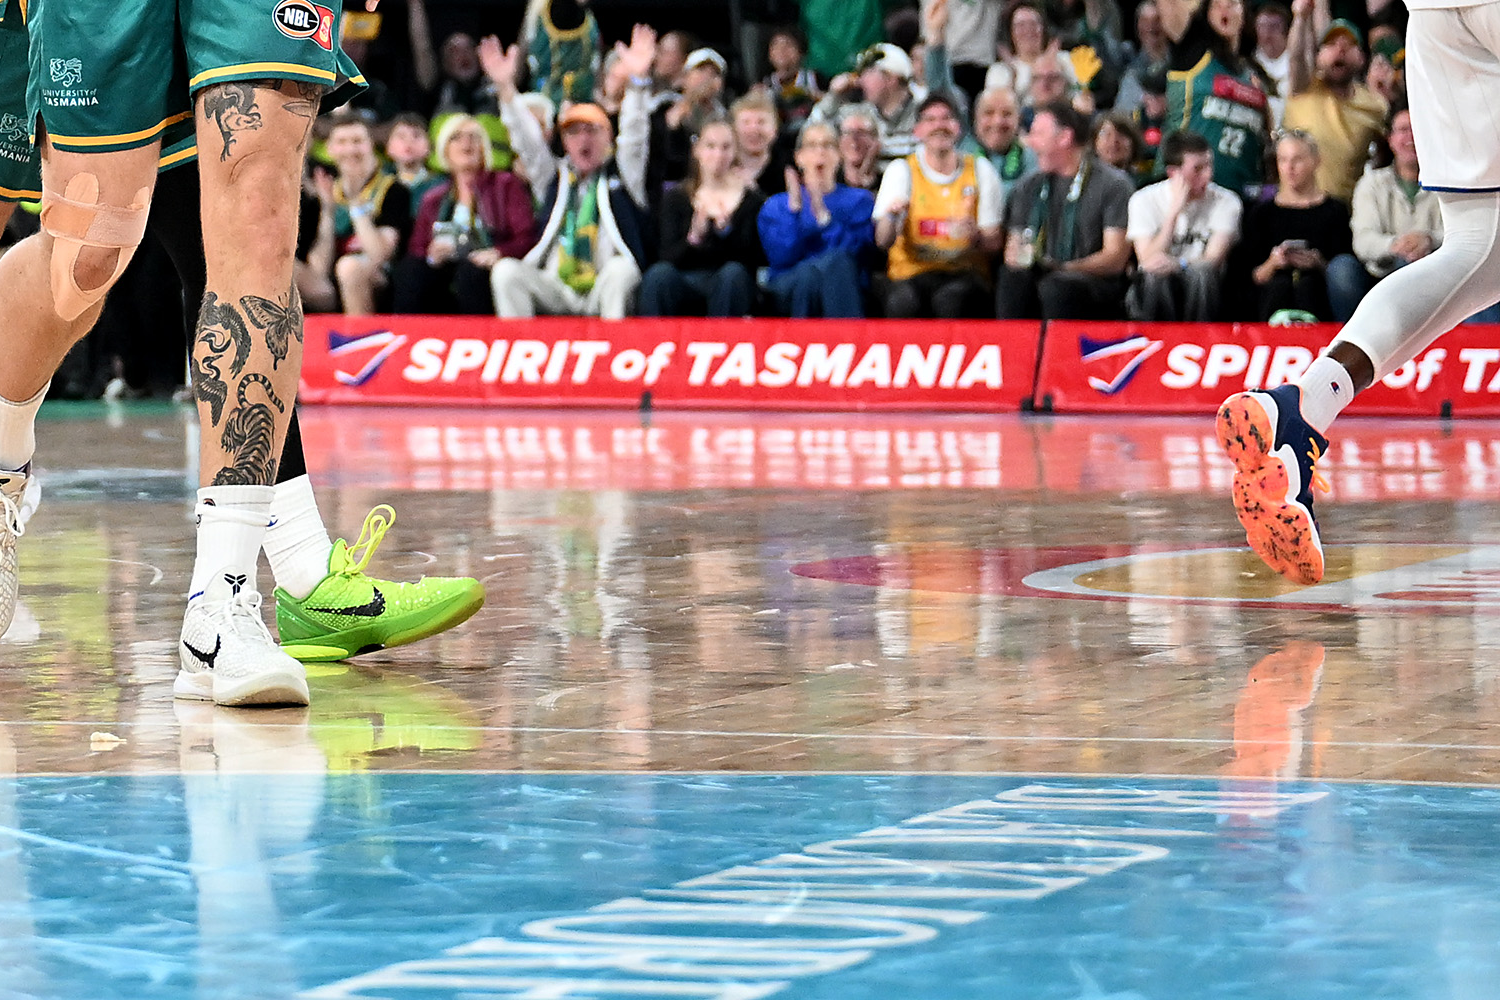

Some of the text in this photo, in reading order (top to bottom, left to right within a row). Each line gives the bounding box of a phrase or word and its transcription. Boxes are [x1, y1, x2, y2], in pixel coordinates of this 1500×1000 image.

[283, 7, 311, 29] NBL
[42, 88, 97, 97] UNIVERSITY of
[43, 96, 99, 107] TASMANIA
[1218, 125, 1247, 158] 22
[404, 339, 1004, 388] SPIRIT of TASMANIA
[1160, 343, 1500, 393] SPIR of T
